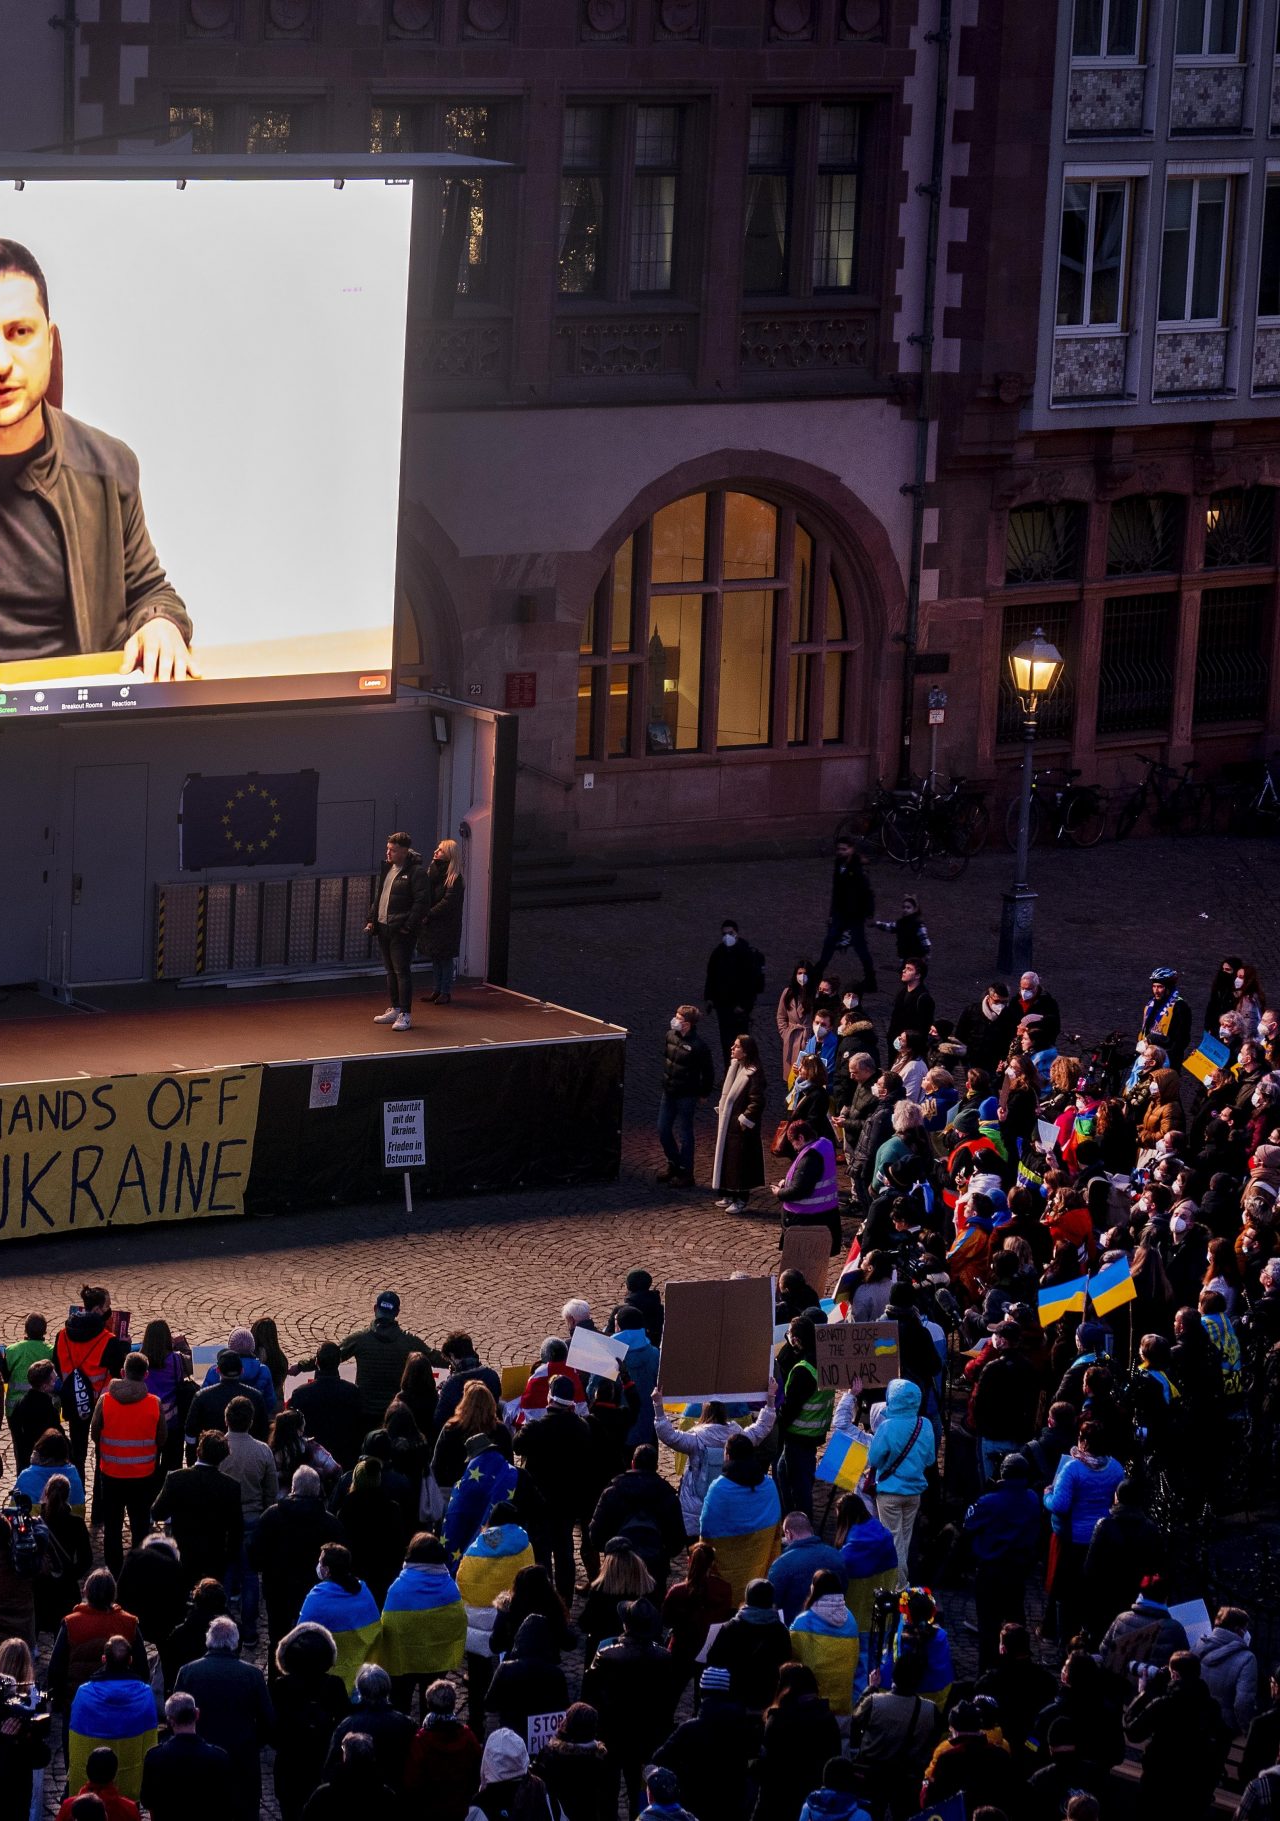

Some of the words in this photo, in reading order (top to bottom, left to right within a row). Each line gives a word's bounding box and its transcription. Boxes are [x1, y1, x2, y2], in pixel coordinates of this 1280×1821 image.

[470, 684, 481, 695] 23
[29, 704, 49, 712] Record
[61, 703, 85, 711] Breakout
[85, 701, 104, 709] Rooms
[111, 699, 137, 708] Reactions
[147, 1075, 246, 1131] OFF
[386, 1102, 422, 1113] Solidarität
[392, 1115, 404, 1124] mit
[404, 1113, 416, 1124] der
[391, 1125, 418, 1136] Ukraine.
[387, 1141, 414, 1152] Frieden
[414, 1140, 422, 1150] in
[386, 1152, 425, 1164] Osteuropa.
[851, 1327, 879, 1341] CLOSE
[828, 1343, 845, 1357] THE
[852, 1343, 871, 1356] SKY
[821, 1364, 840, 1387] NO
[845, 1361, 881, 1386] WAR
[533, 1714, 564, 1733] STOP
